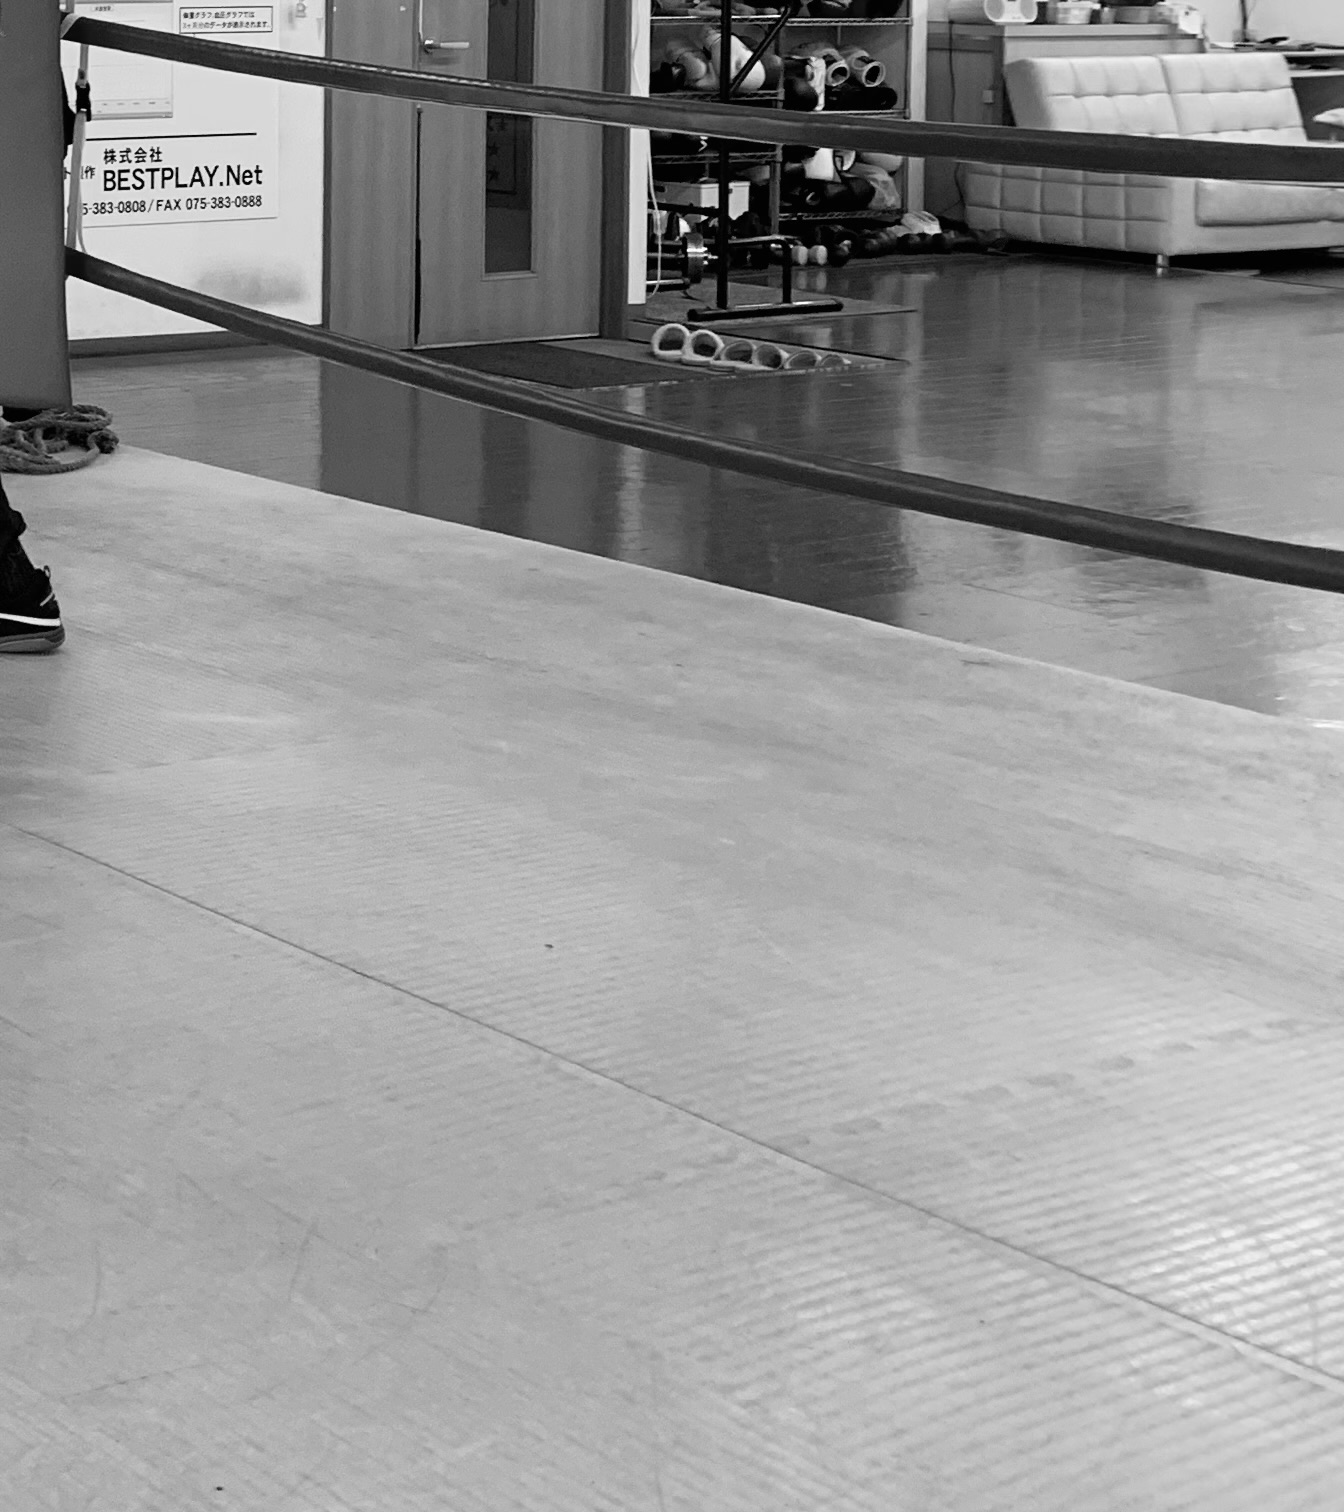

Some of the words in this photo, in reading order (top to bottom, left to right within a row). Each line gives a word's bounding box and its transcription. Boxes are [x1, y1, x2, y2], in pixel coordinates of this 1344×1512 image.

[103, 146, 162, 165] 株式会社
[103, 164, 263, 191] BESTPLAY.Net
[185, 195, 262, 210] 075-383-0888
